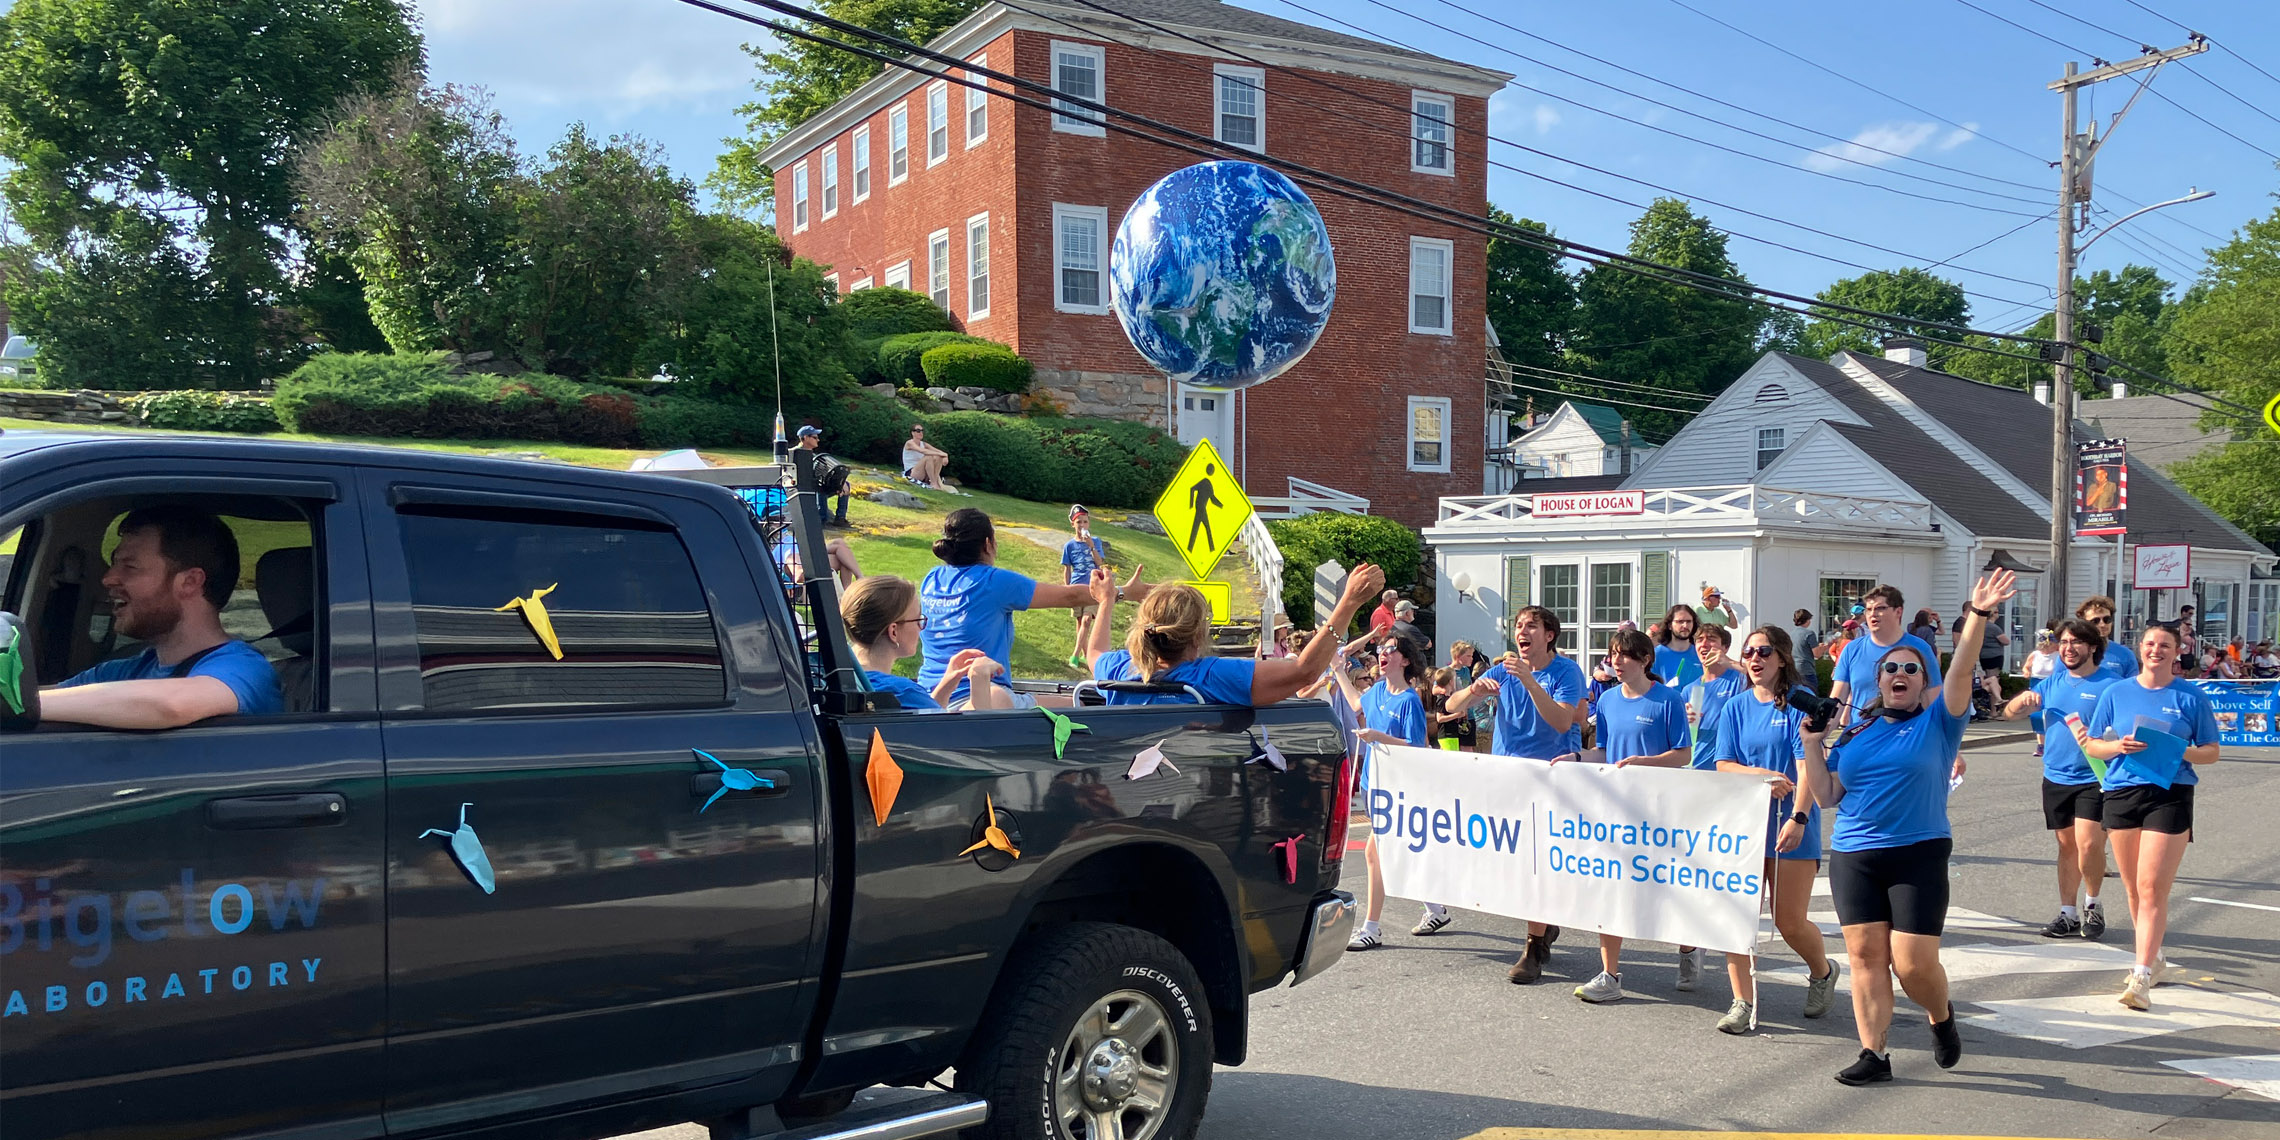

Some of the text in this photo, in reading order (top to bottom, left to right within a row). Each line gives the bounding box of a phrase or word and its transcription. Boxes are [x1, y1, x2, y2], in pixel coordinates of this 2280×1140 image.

[1541, 497, 1634, 511] HOUSE OF LOGAN
[2250, 699, 2274, 710] Self
[2221, 733, 2239, 742] For
[2241, 733, 2262, 743] The
[1370, 789, 1522, 855] Bigelow
[1549, 810, 1749, 858] Laboratory for
[1549, 846, 1760, 896] Ocean Sciences
[2, 957, 322, 1018] ABORATORY
[1122, 966, 1198, 1033] DISCOVERER
